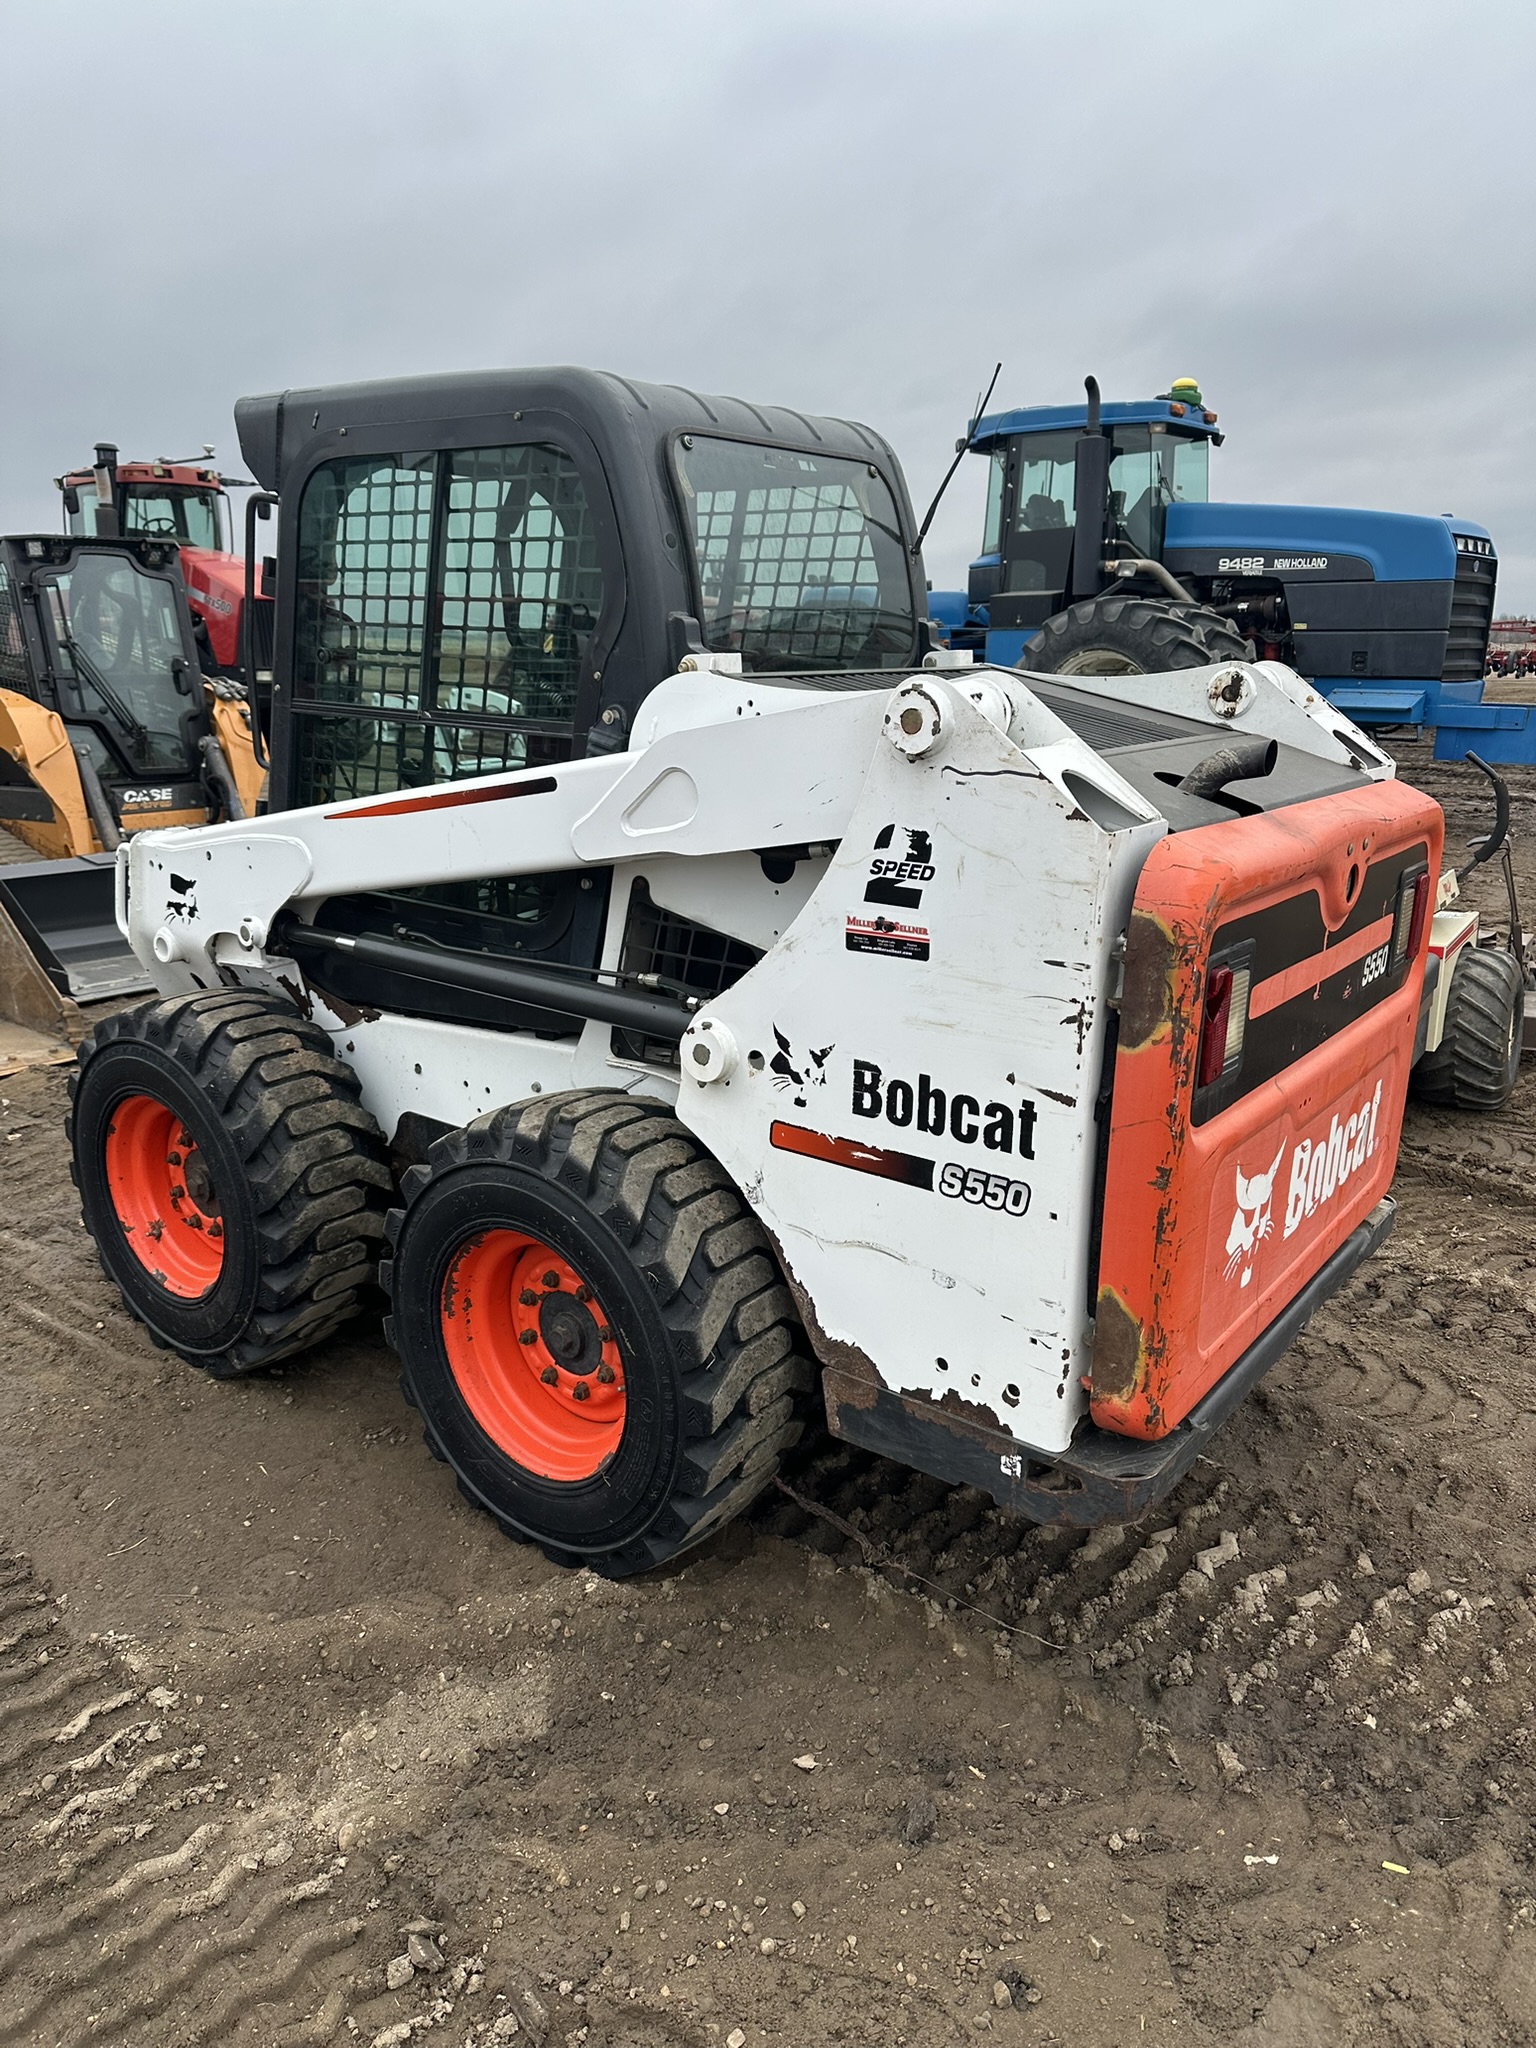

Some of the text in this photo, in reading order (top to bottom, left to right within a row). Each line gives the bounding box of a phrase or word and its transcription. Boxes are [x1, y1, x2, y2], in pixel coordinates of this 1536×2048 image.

[1218, 557, 1265, 570] 9482
[1274, 557, 1328, 569] NEW HOLLAND
[123, 788, 173, 803] CASE
[869, 858, 936, 882] SPEED
[1361, 944, 1389, 987] S550
[852, 1058, 1038, 1161] Bobcat
[1283, 1078, 1383, 1242] Bobcat
[938, 1162, 1032, 1218] S550
